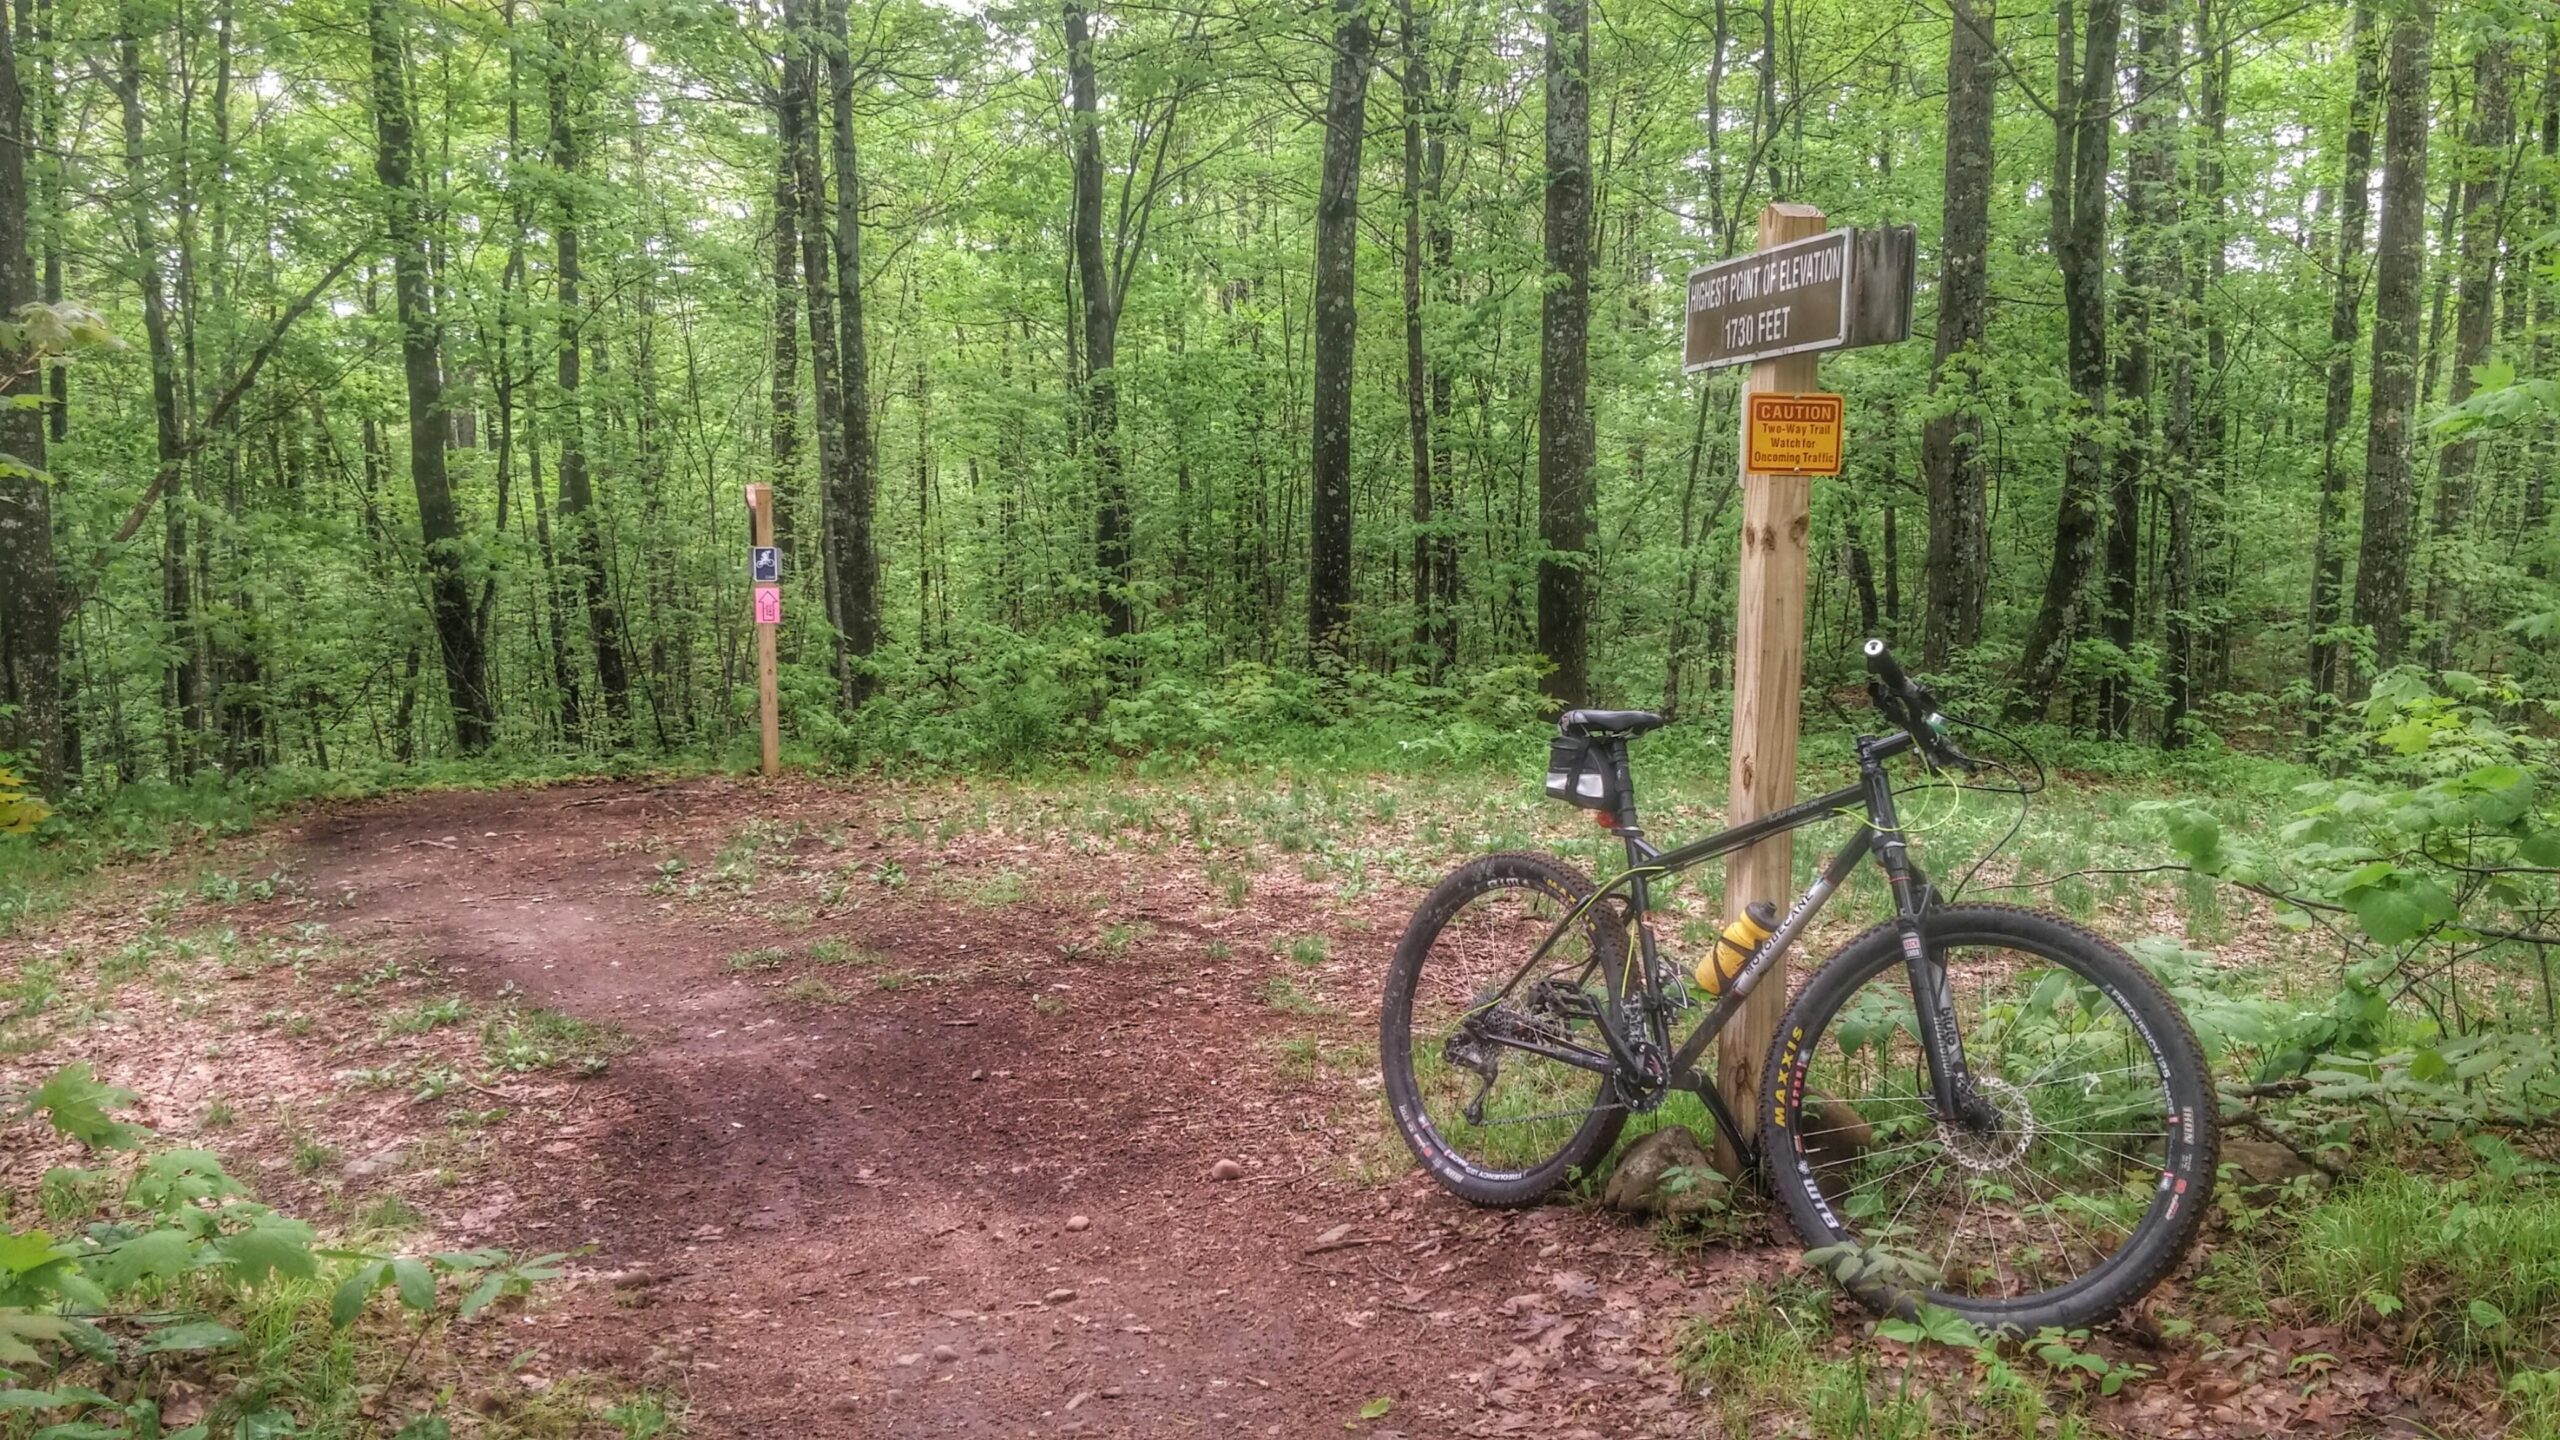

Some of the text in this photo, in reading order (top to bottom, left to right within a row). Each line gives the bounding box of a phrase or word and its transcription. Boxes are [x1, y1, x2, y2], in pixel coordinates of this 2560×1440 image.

[1690, 246, 1841, 313] HIGHEST POINT OF ELEVATION
[1725, 306, 1791, 349] 1730 FEET
[1761, 405, 1831, 420] CAUTION
[1762, 423, 1831, 436] Two-Way Trail
[1754, 451, 1834, 464] Oncoming Traffic
[1771, 437, 1815, 448] Watch for
[1745, 893, 1814, 976] MOTOBECANE
[2110, 989, 2161, 1055] FREQUENCY
[1774, 1026, 1803, 1127] MAXXIS
[1803, 1178, 1840, 1229] WTB
